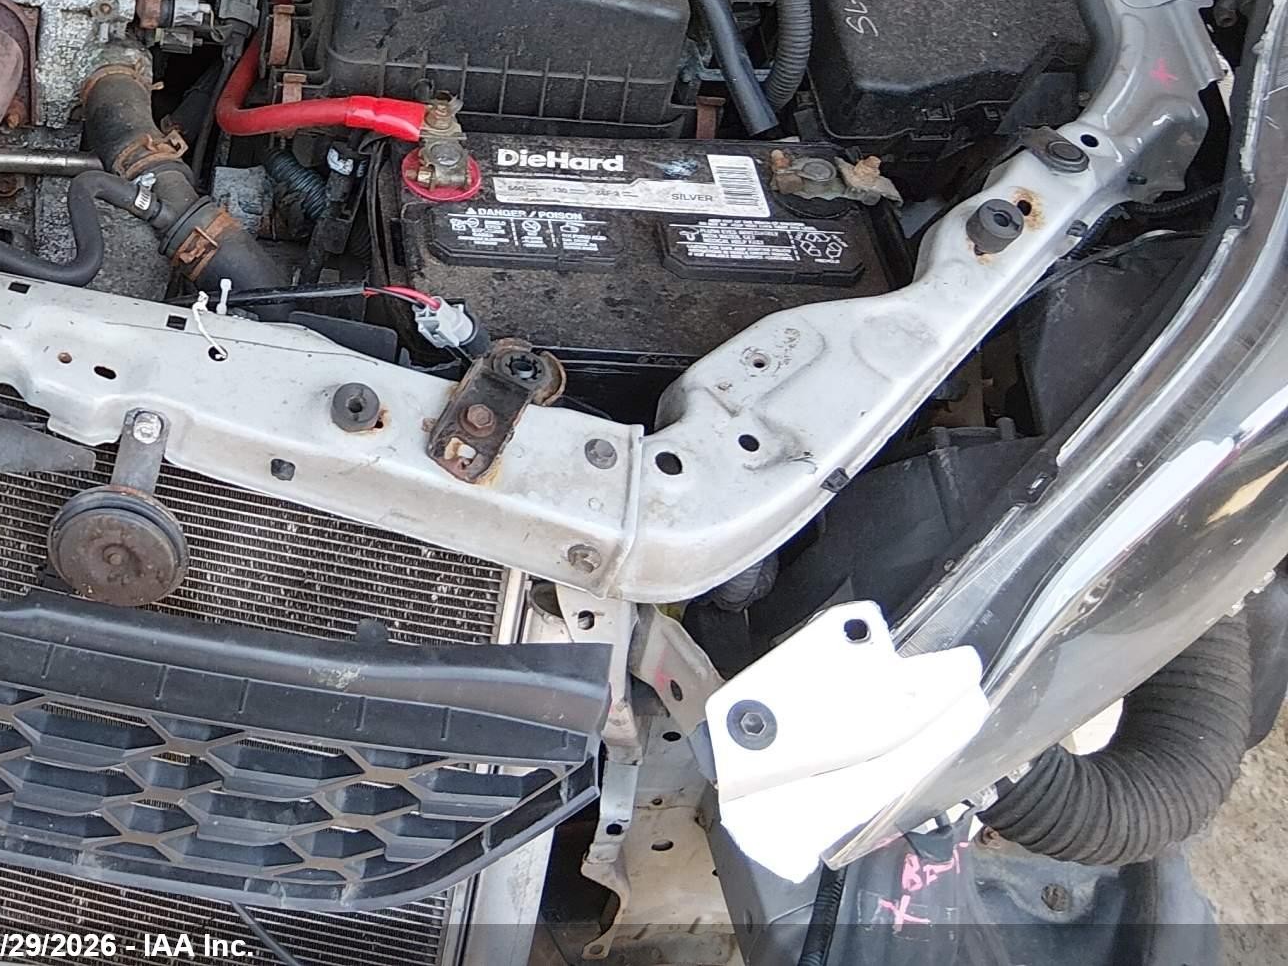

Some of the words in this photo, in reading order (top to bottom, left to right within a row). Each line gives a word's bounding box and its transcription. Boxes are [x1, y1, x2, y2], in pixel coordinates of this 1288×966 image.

[496, 148, 624, 172] DieHard
[671, 193, 713, 202] SILVER
[477, 209, 527, 218] DANGER
[538, 210, 583, 221] POISON
